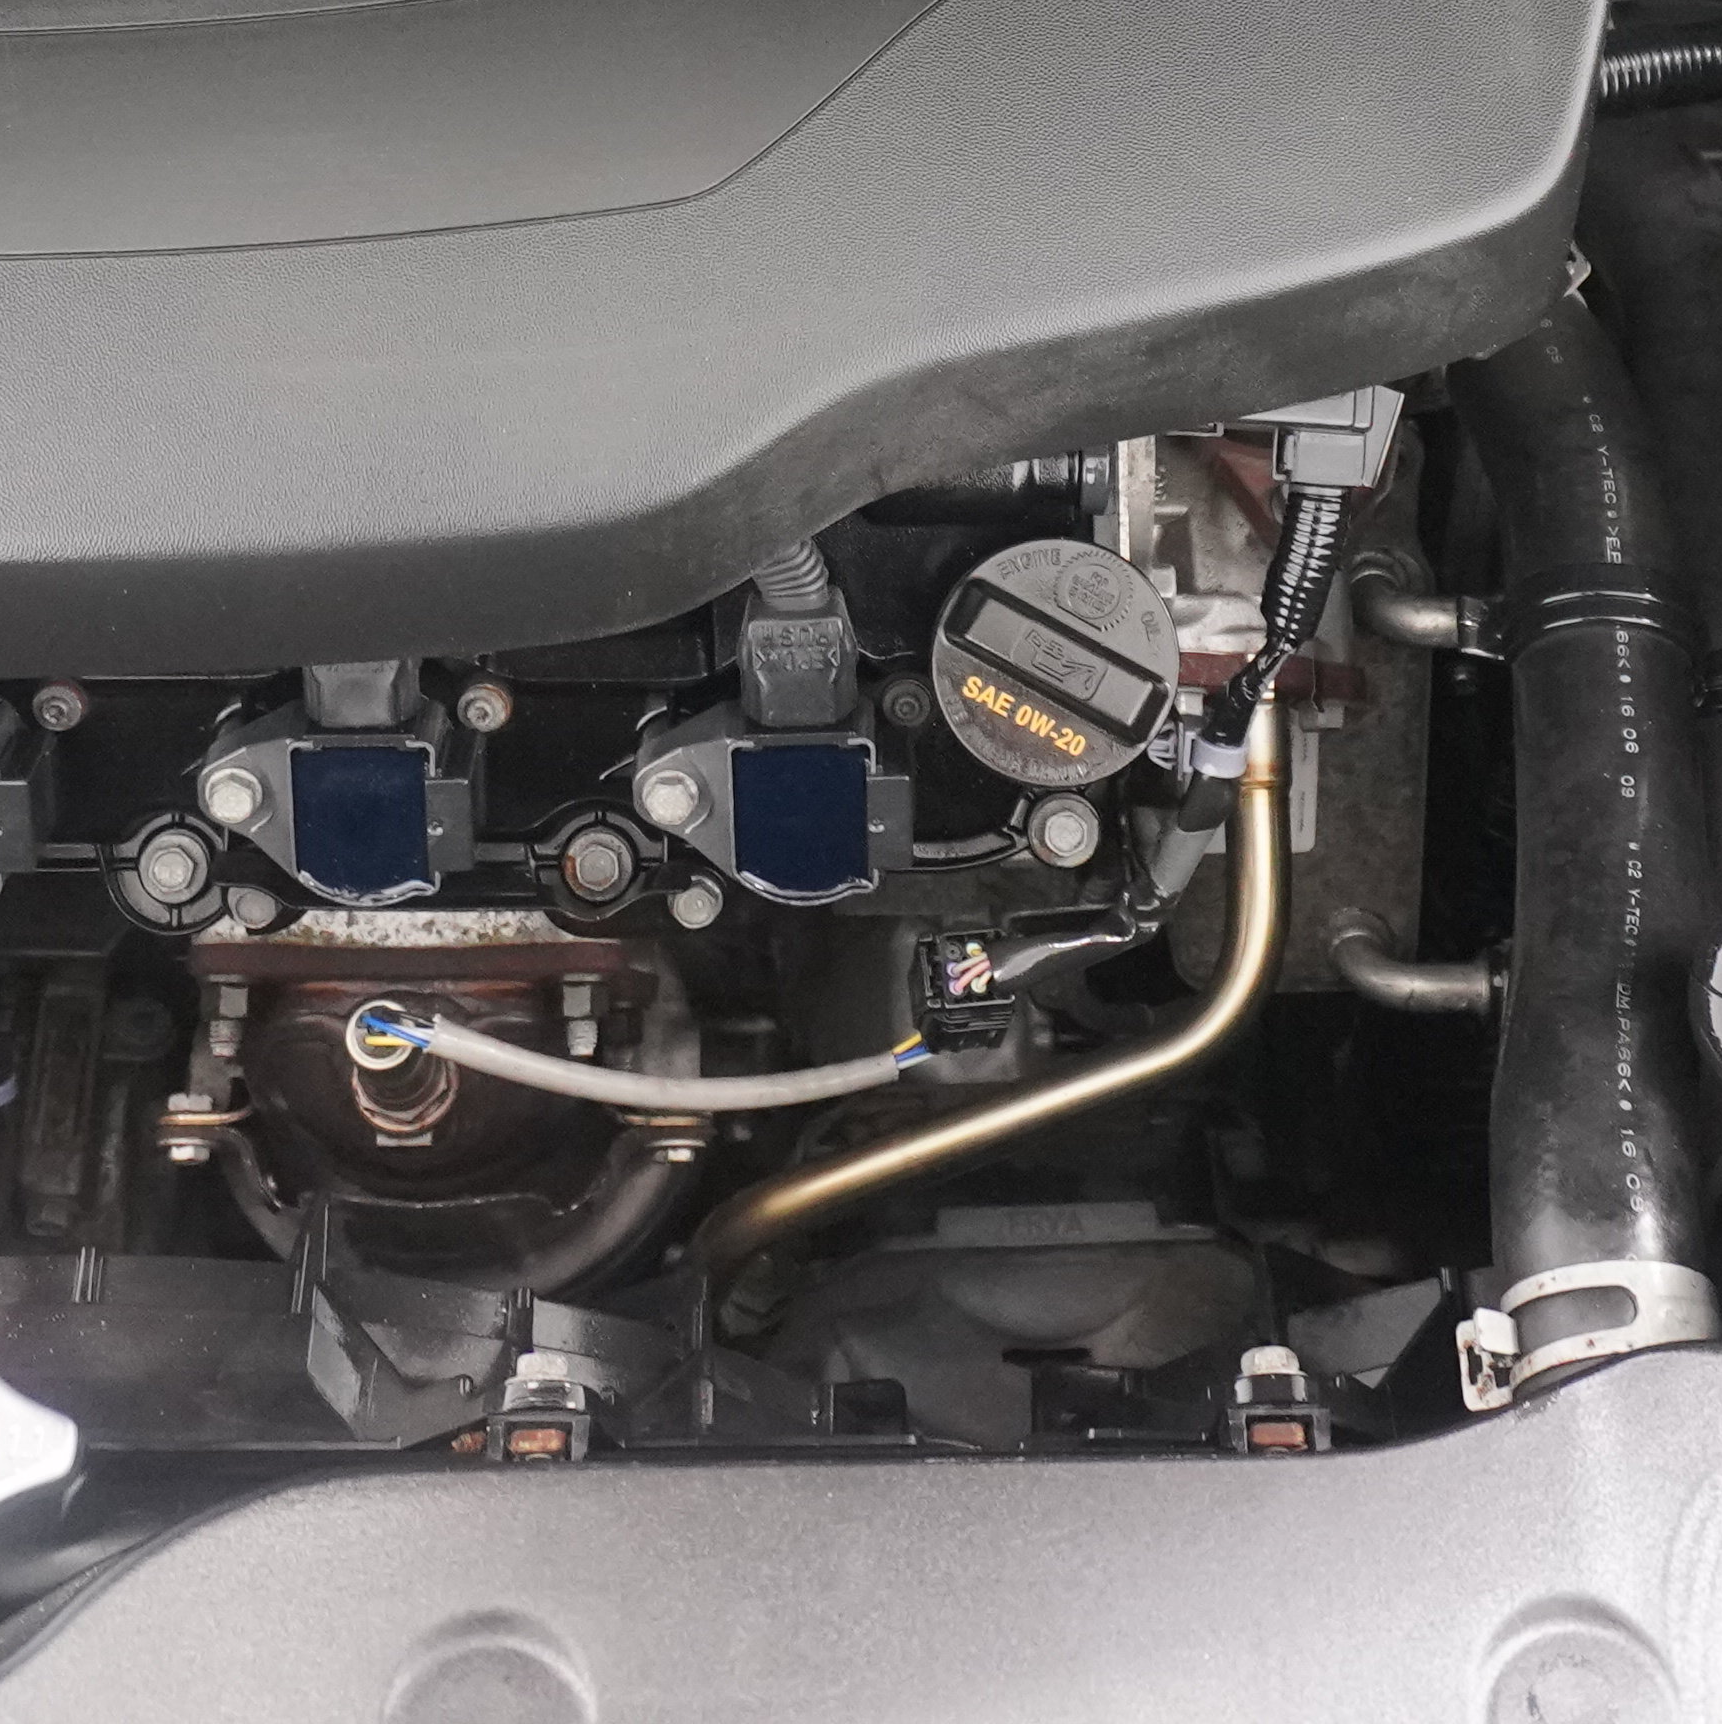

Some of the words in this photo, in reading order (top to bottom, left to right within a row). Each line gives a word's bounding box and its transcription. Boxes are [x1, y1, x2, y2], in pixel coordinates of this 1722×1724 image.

[1597, 445, 1617, 505] Y-TEC
[996, 547, 1063, 581] ENGINE
[961, 675, 1015, 718] SAE
[1015, 704, 1087, 757] 0W-20
[1621, 695, 1635, 717] 16
[1623, 727, 1640, 754] 06
[1620, 775, 1635, 798] 09
[1627, 859, 1643, 880] C2
[1624, 888, 1641, 936] Y-TEC
[1620, 1128, 1636, 1158] 16
